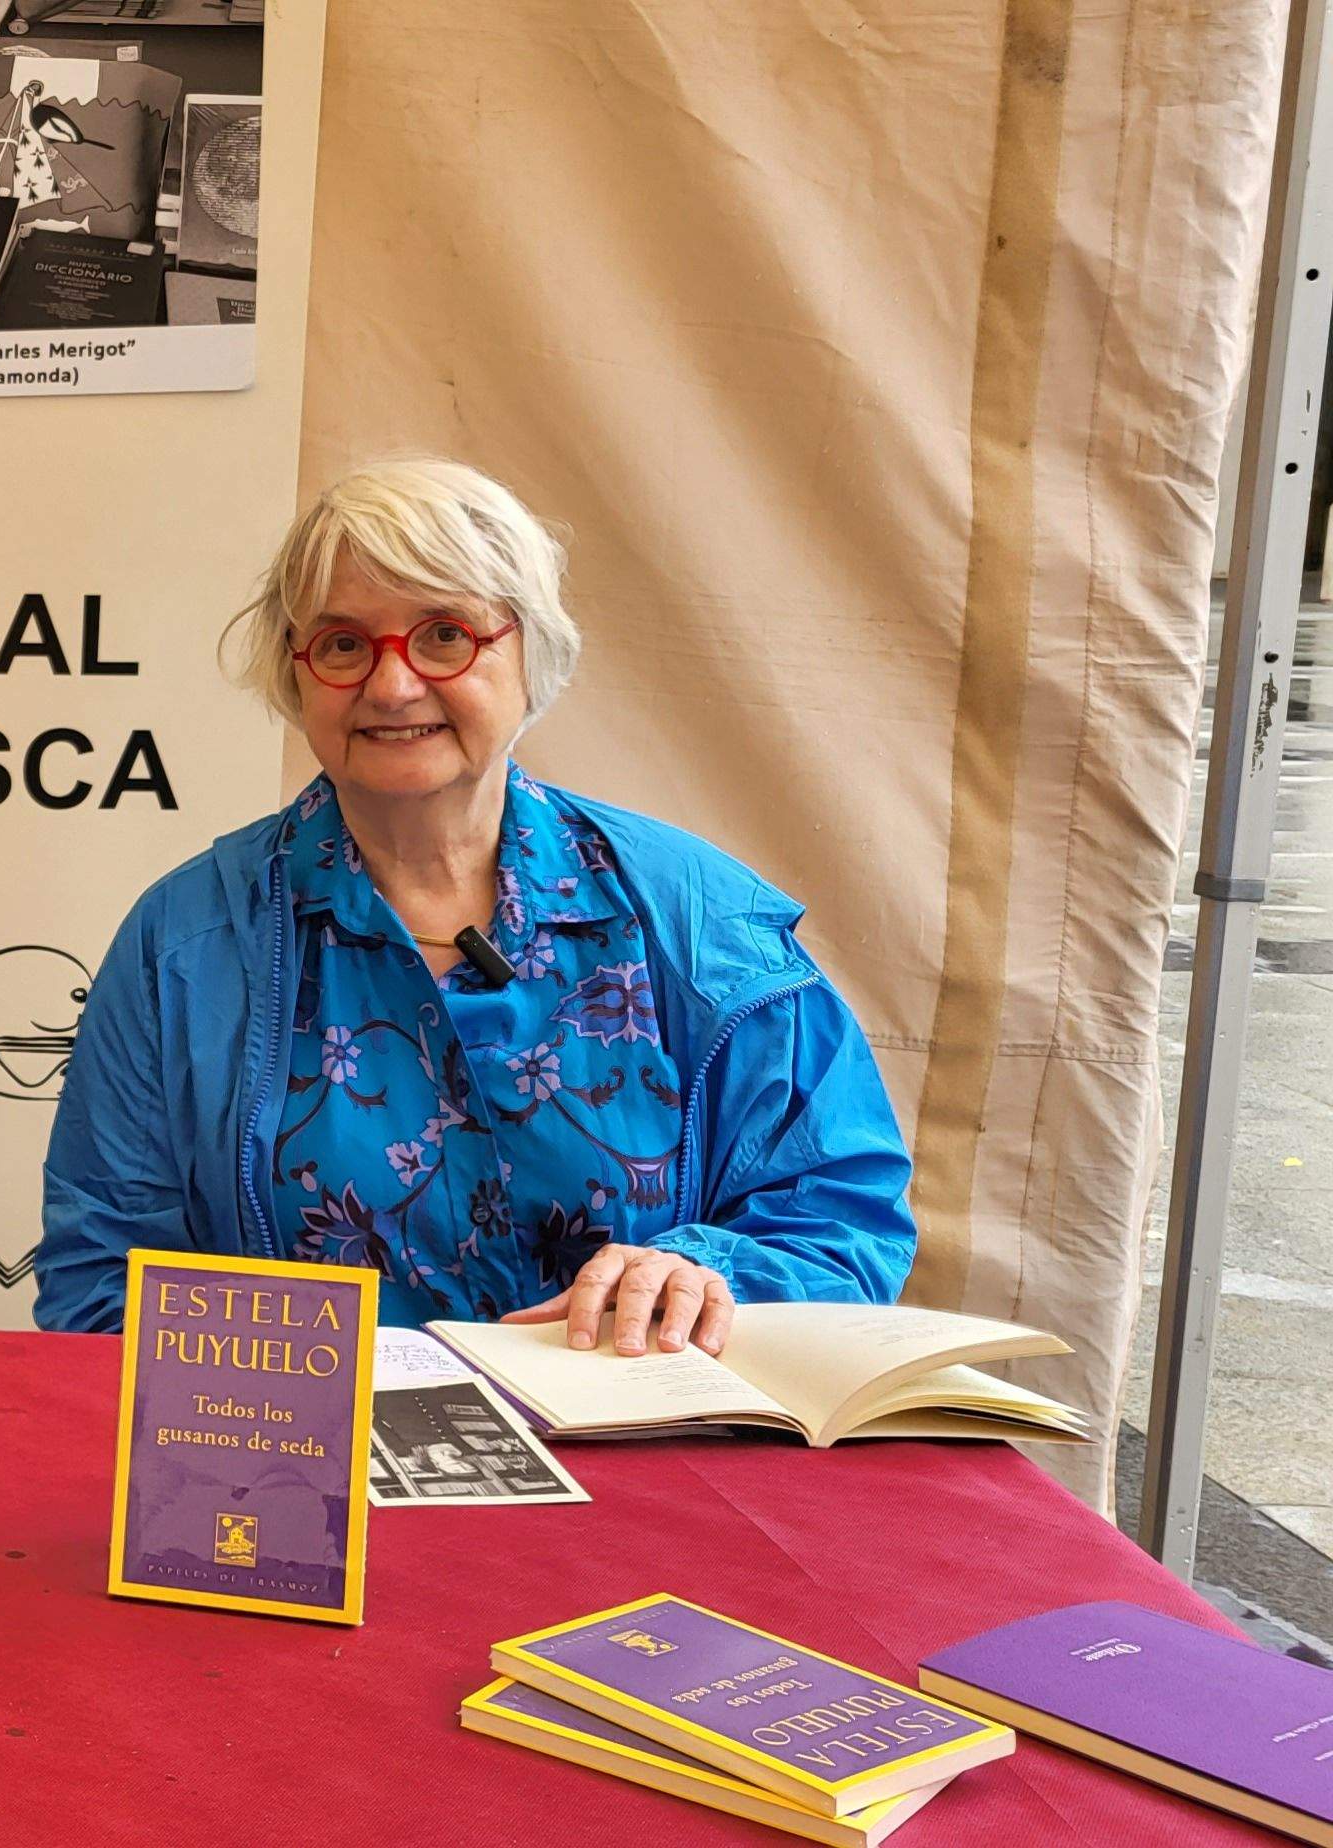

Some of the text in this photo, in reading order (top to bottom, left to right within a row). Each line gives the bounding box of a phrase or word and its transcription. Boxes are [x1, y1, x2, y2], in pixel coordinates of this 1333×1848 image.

[34, 262, 133, 284] DICCIONARIO
[159, 1283, 341, 1332] ESTELA
[155, 1328, 340, 1378] PUYUELO
[192, 1394, 293, 1423] Todos los
[157, 1425, 326, 1458] gusanos de seda
[672, 1655, 800, 1705] gusanos de seda
[725, 1677, 813, 1710] Todos los
[752, 1689, 907, 1747] PUYUELO
[795, 1709, 957, 1768] ESTELA
